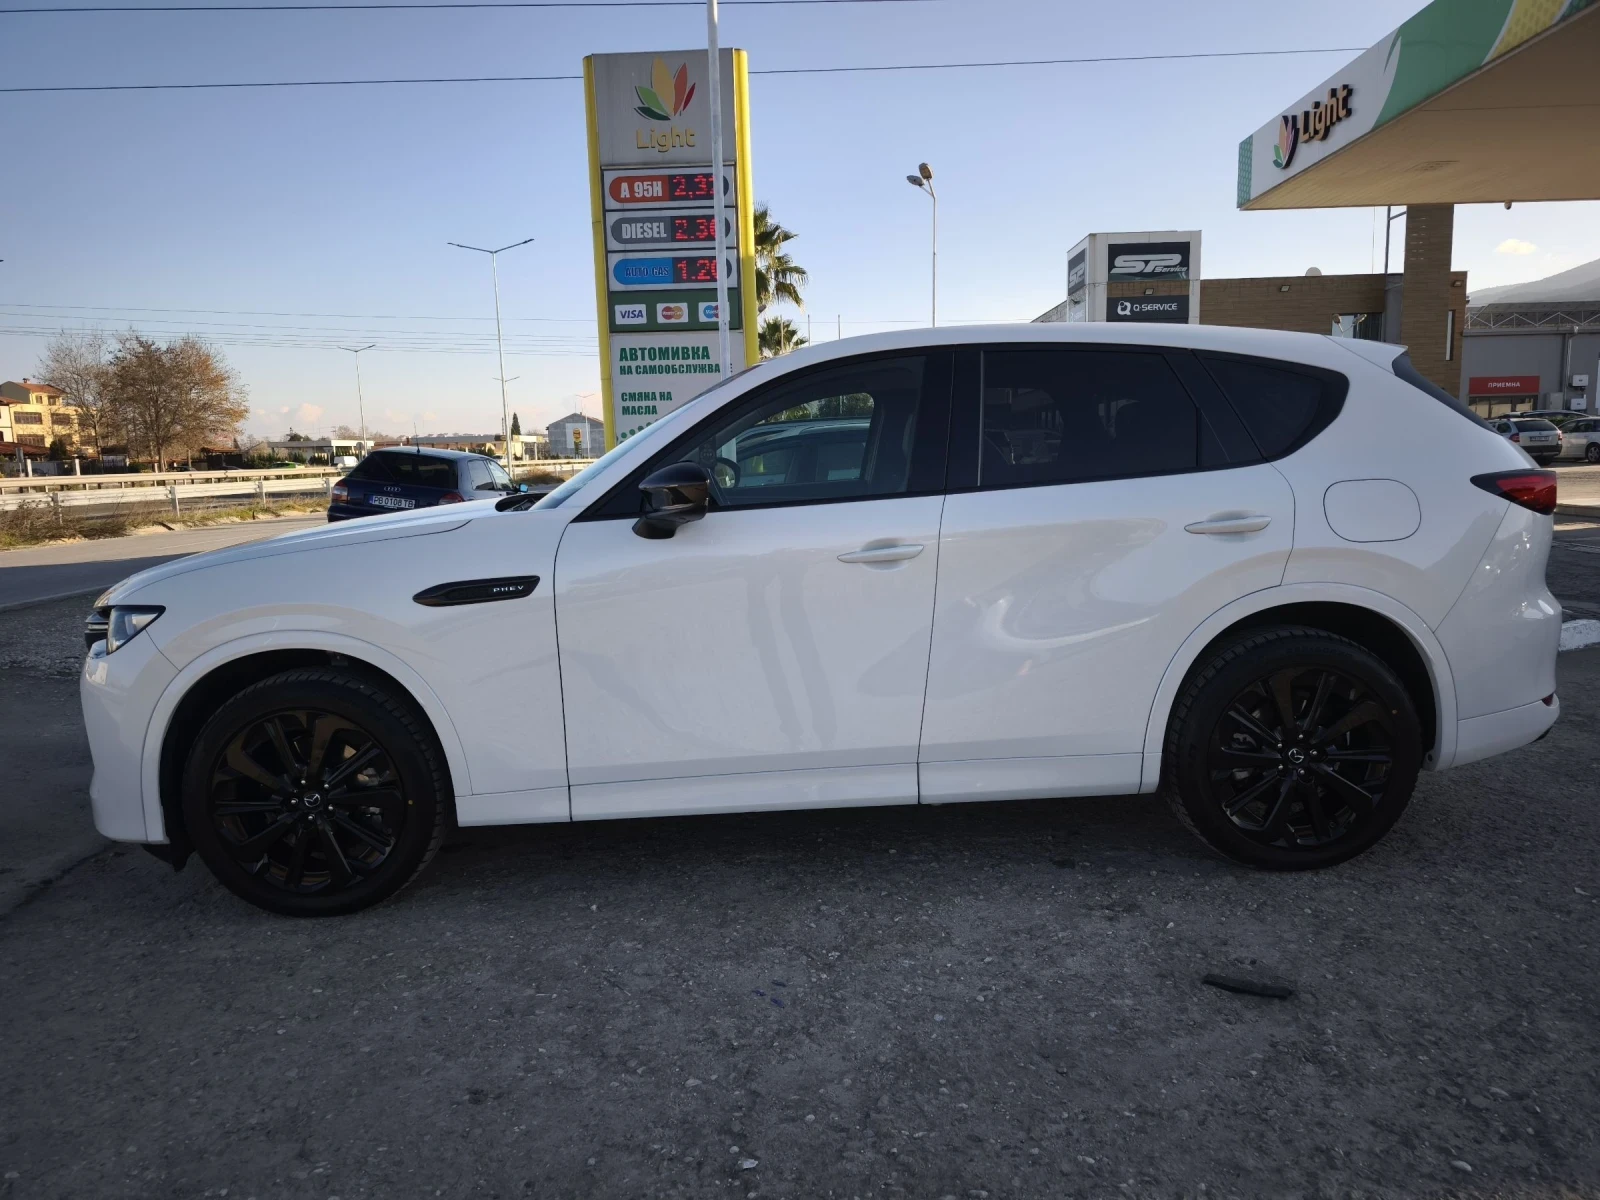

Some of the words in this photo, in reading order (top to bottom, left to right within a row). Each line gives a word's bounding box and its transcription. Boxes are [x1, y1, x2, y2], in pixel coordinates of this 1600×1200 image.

[1299, 84, 1353, 143] Light
[635, 127, 696, 153] Light
[622, 222, 667, 239] DIESEL
[1110, 253, 1182, 274] SP
[1154, 265, 1188, 273] Service
[625, 266, 648, 277] AUTO
[652, 266, 669, 277] GAS
[619, 309, 644, 319] VISA
[619, 346, 711, 361] АВТОМИВКА
[619, 364, 633, 375] НА
[621, 392, 657, 402] СМЯНА
[659, 391, 673, 401] НА
[621, 405, 658, 416] МАСЛА
